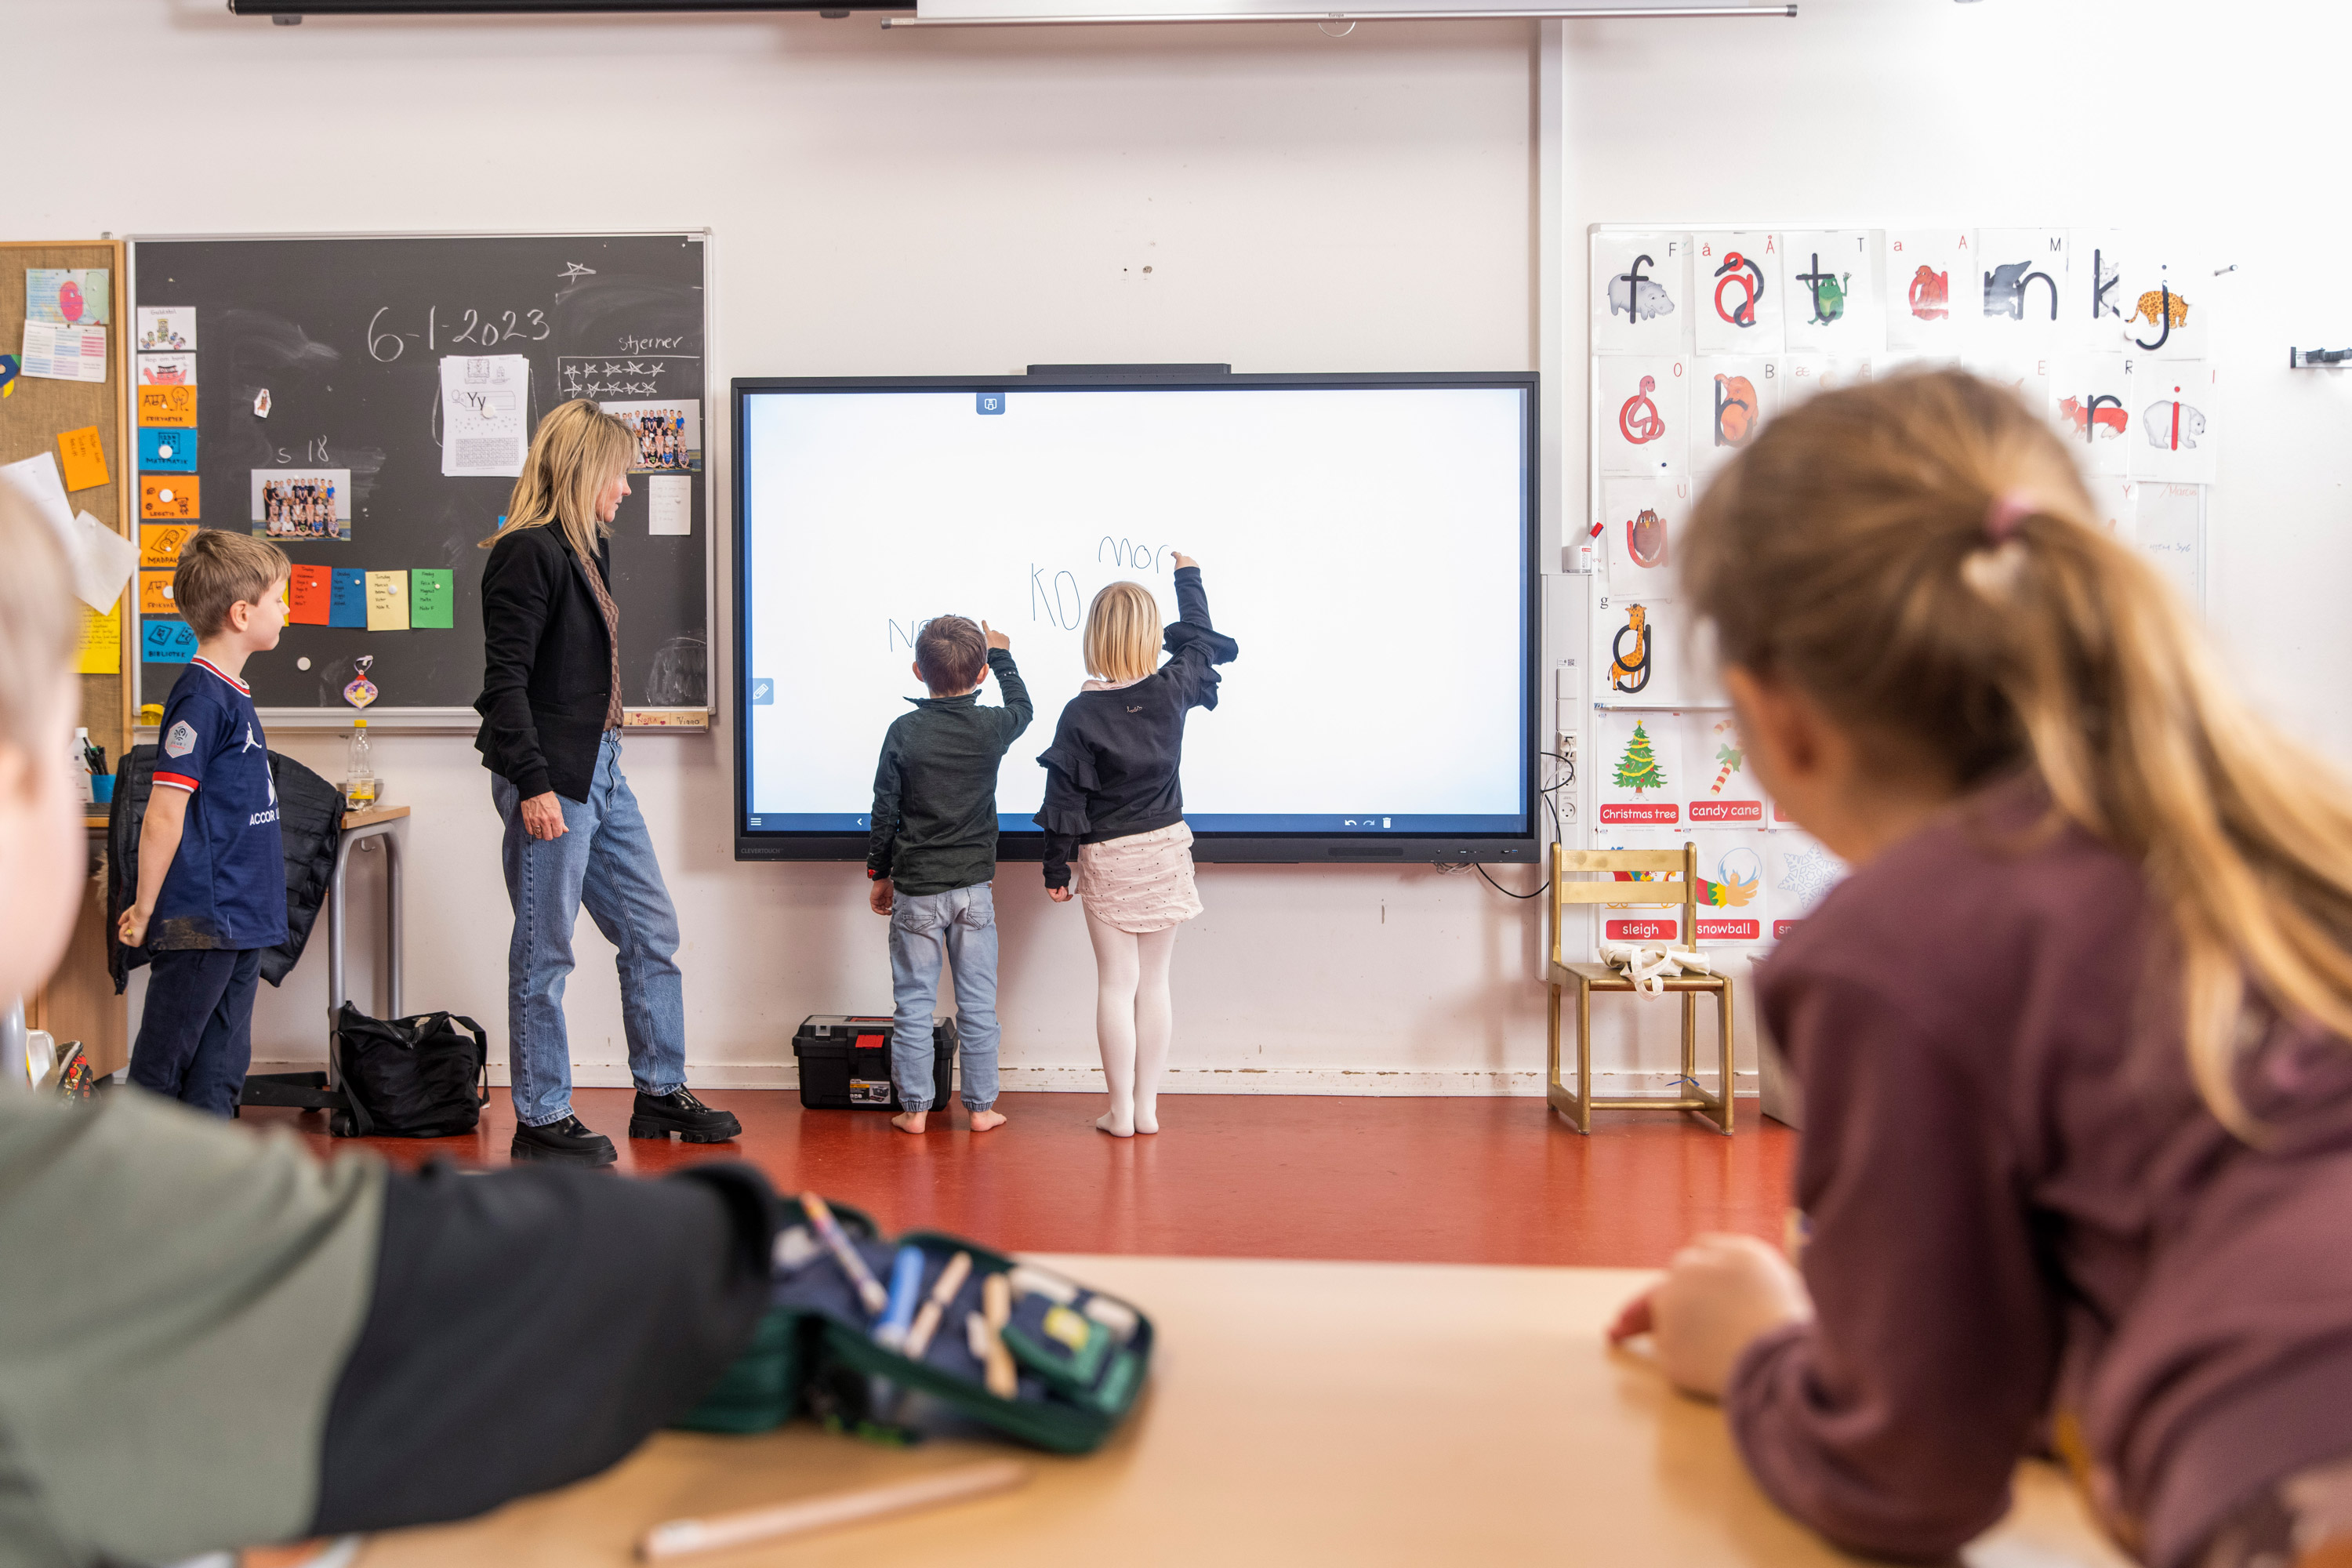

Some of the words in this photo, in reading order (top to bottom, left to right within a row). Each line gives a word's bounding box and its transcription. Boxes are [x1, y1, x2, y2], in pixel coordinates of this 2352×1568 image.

[1668, 241, 1677, 256] F
[1702, 243, 1711, 257] å
[1766, 234, 1775, 254] Å
[1857, 238, 1864, 252] T
[1893, 239, 1903, 252] a
[1958, 236, 1967, 250] A
[2049, 238, 2061, 252] M
[1795, 252, 1835, 323] t
[368, 306, 550, 362] 6-1-2023
[619, 333, 684, 355] stjerner
[1766, 365, 1774, 379] B
[1795, 365, 1810, 377] æ
[2038, 360, 2045, 376] E
[307, 434, 329, 463] 18
[1677, 484, 1686, 499] U
[2122, 485, 2131, 499] Y
[1600, 596, 1609, 610] g
[1612, 624, 1652, 694] g
[1602, 809, 1653, 819] Christmas
[1654, 809, 1676, 819] tree
[1692, 804, 1728, 818] candy
[1731, 806, 1759, 815] cane
[249, 812, 275, 826] ACCOR
[1622, 924, 1659, 938] sleigh
[1697, 923, 1750, 935] snowball
